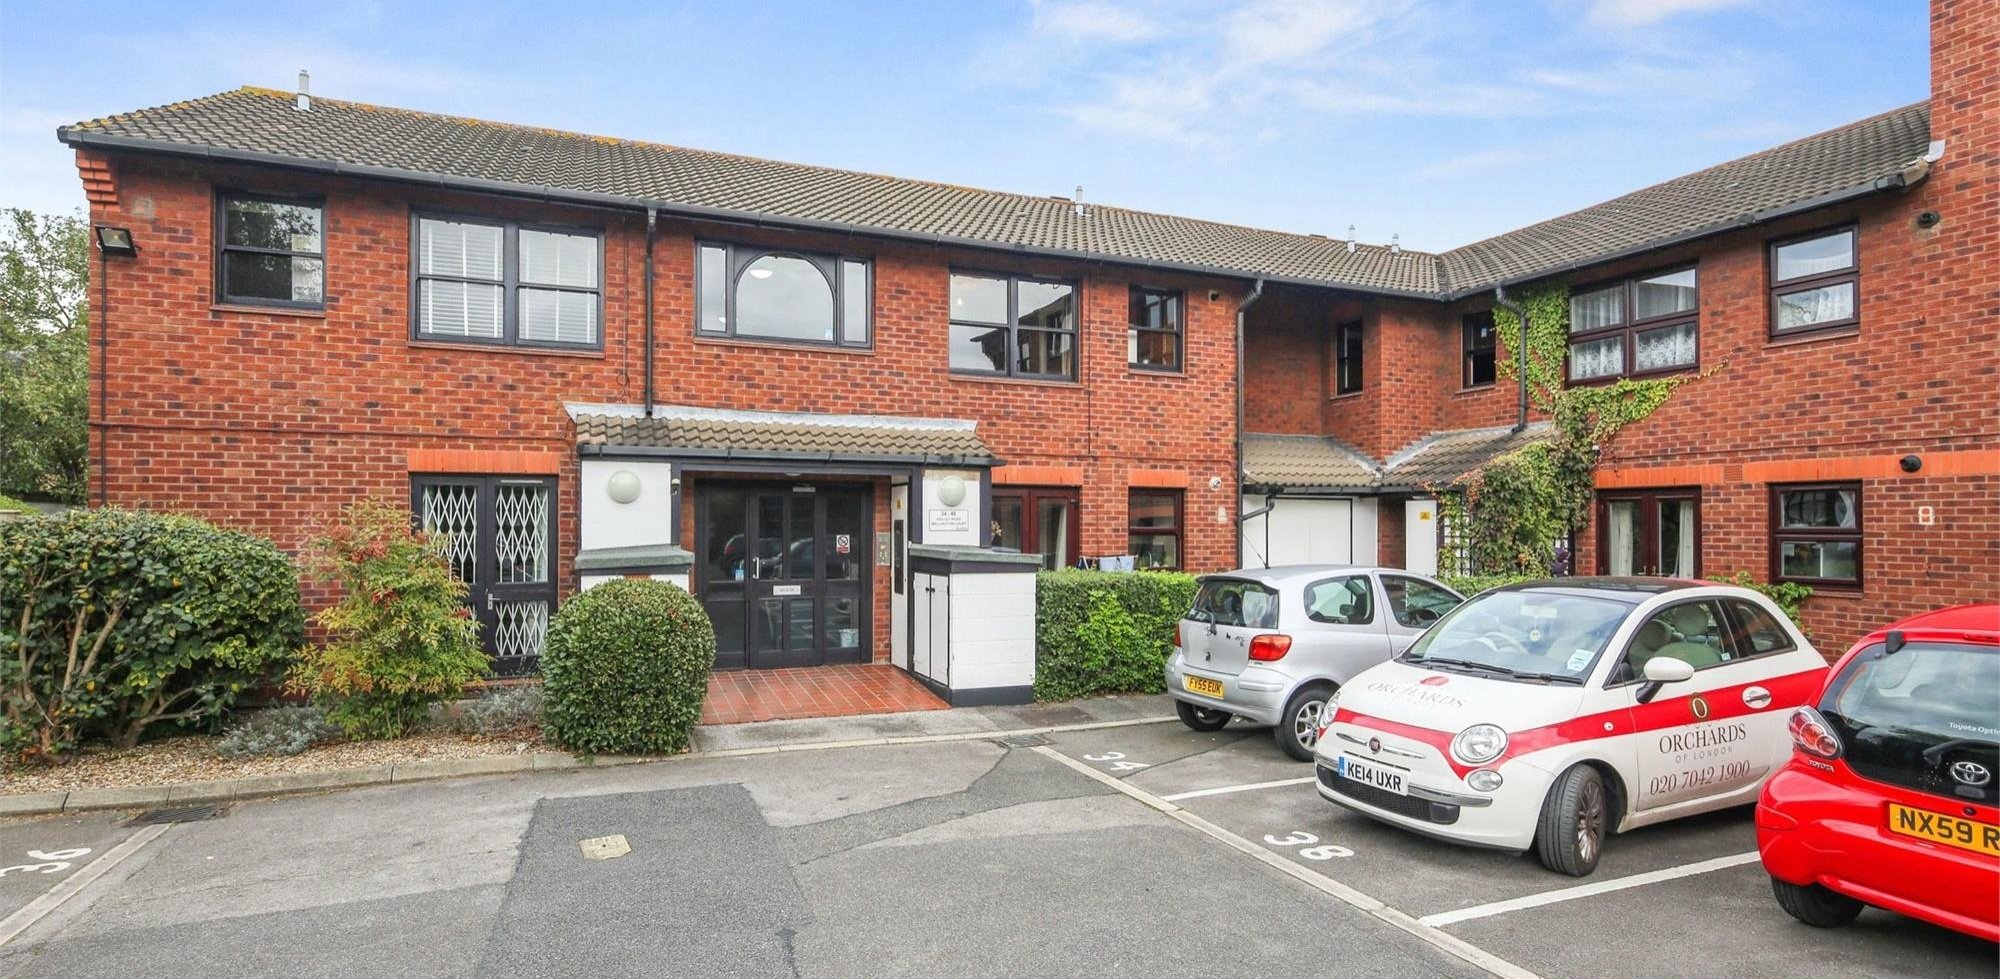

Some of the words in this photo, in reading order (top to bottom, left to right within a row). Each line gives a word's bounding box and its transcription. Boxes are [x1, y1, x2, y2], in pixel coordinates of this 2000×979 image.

[1189, 677, 1207, 691] FY55
[1367, 682, 1463, 707] ORCHARDS
[1659, 722, 1747, 754] ORCHARDS
[1948, 722, 1977, 731] Toyota
[1083, 751, 1151, 771] 34
[1675, 753, 1687, 764] OF
[1693, 746, 1733, 760] LONDON
[1808, 759, 1835, 773] TOYOTA
[1347, 761, 1373, 782] KE14
[1376, 770, 1401, 791] UXR
[1650, 774, 1677, 796] 020
[1682, 766, 1715, 790] 7042
[1720, 760, 1750, 781] 1900
[1900, 807, 1973, 844] NX59
[1263, 830, 1355, 861] 38
[0, 847, 92, 878] 36
